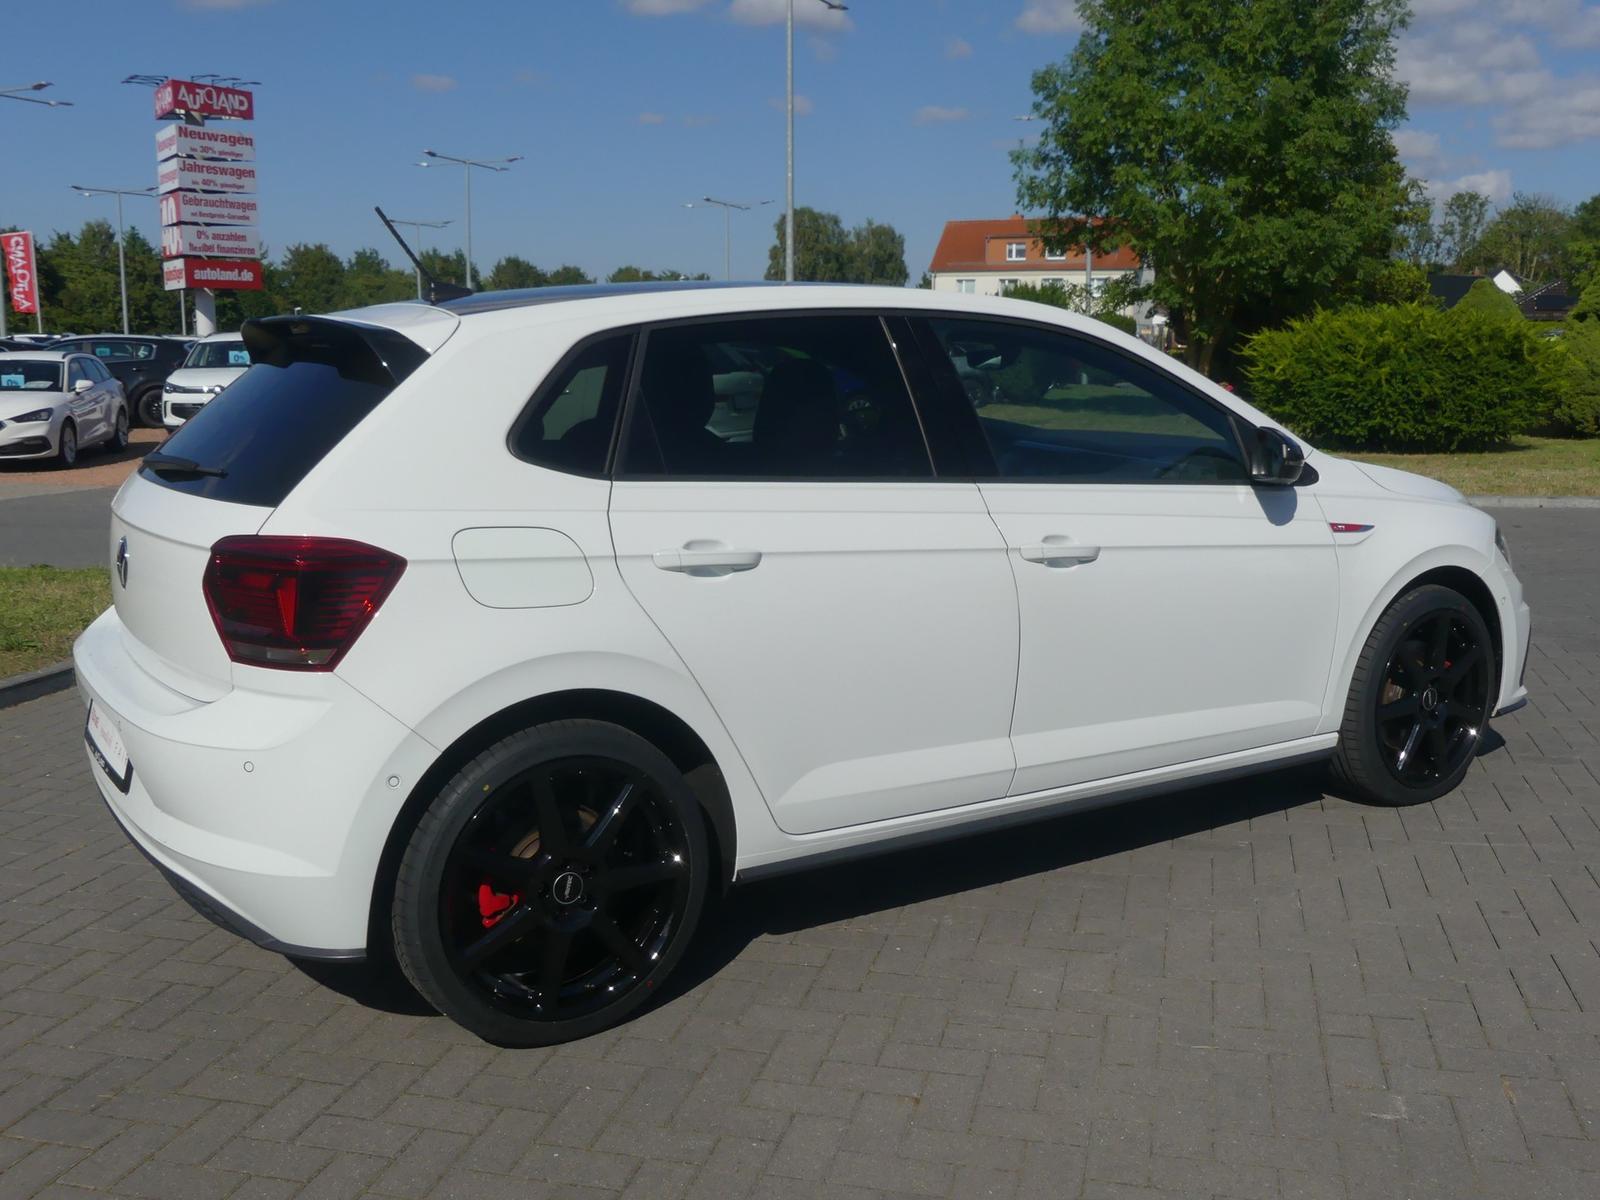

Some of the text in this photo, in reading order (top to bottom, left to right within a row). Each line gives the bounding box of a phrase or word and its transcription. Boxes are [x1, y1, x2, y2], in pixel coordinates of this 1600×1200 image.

[178, 126, 253, 147] Neuwagen
[180, 160, 256, 180] Jahreswagen
[182, 194, 257, 213] Gebrauchtwagen
[196, 230, 210, 240] 0%
[193, 267, 254, 282] autoland.de
